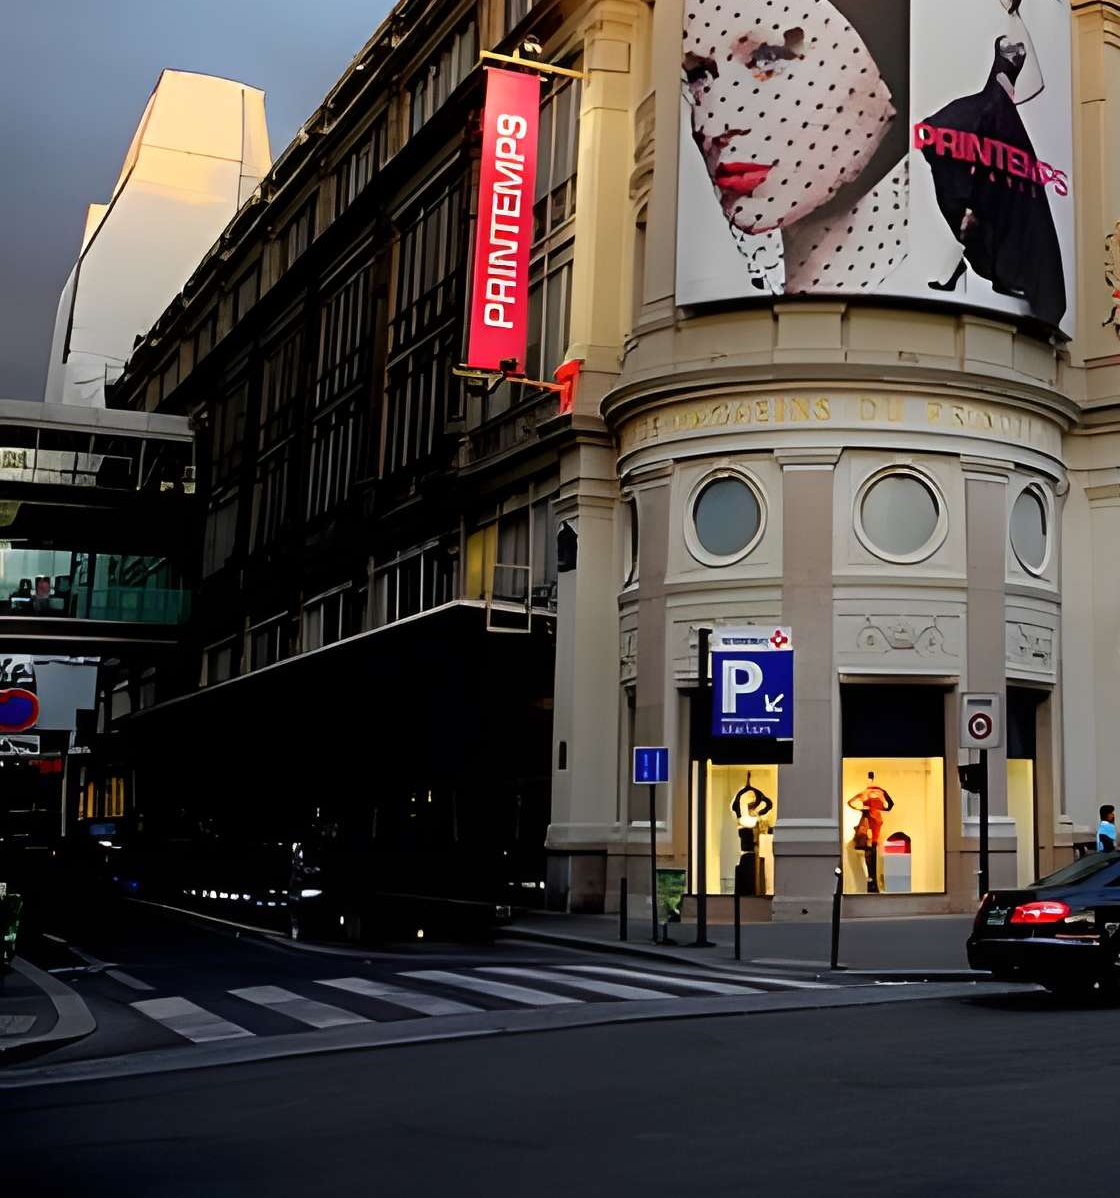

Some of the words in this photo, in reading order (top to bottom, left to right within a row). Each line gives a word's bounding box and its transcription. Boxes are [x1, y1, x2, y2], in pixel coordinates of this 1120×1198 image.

[913, 122, 1068, 196] PRINTEMPS
[484, 113, 527, 329] PRINTEMPS
[722, 659, 764, 713] P
